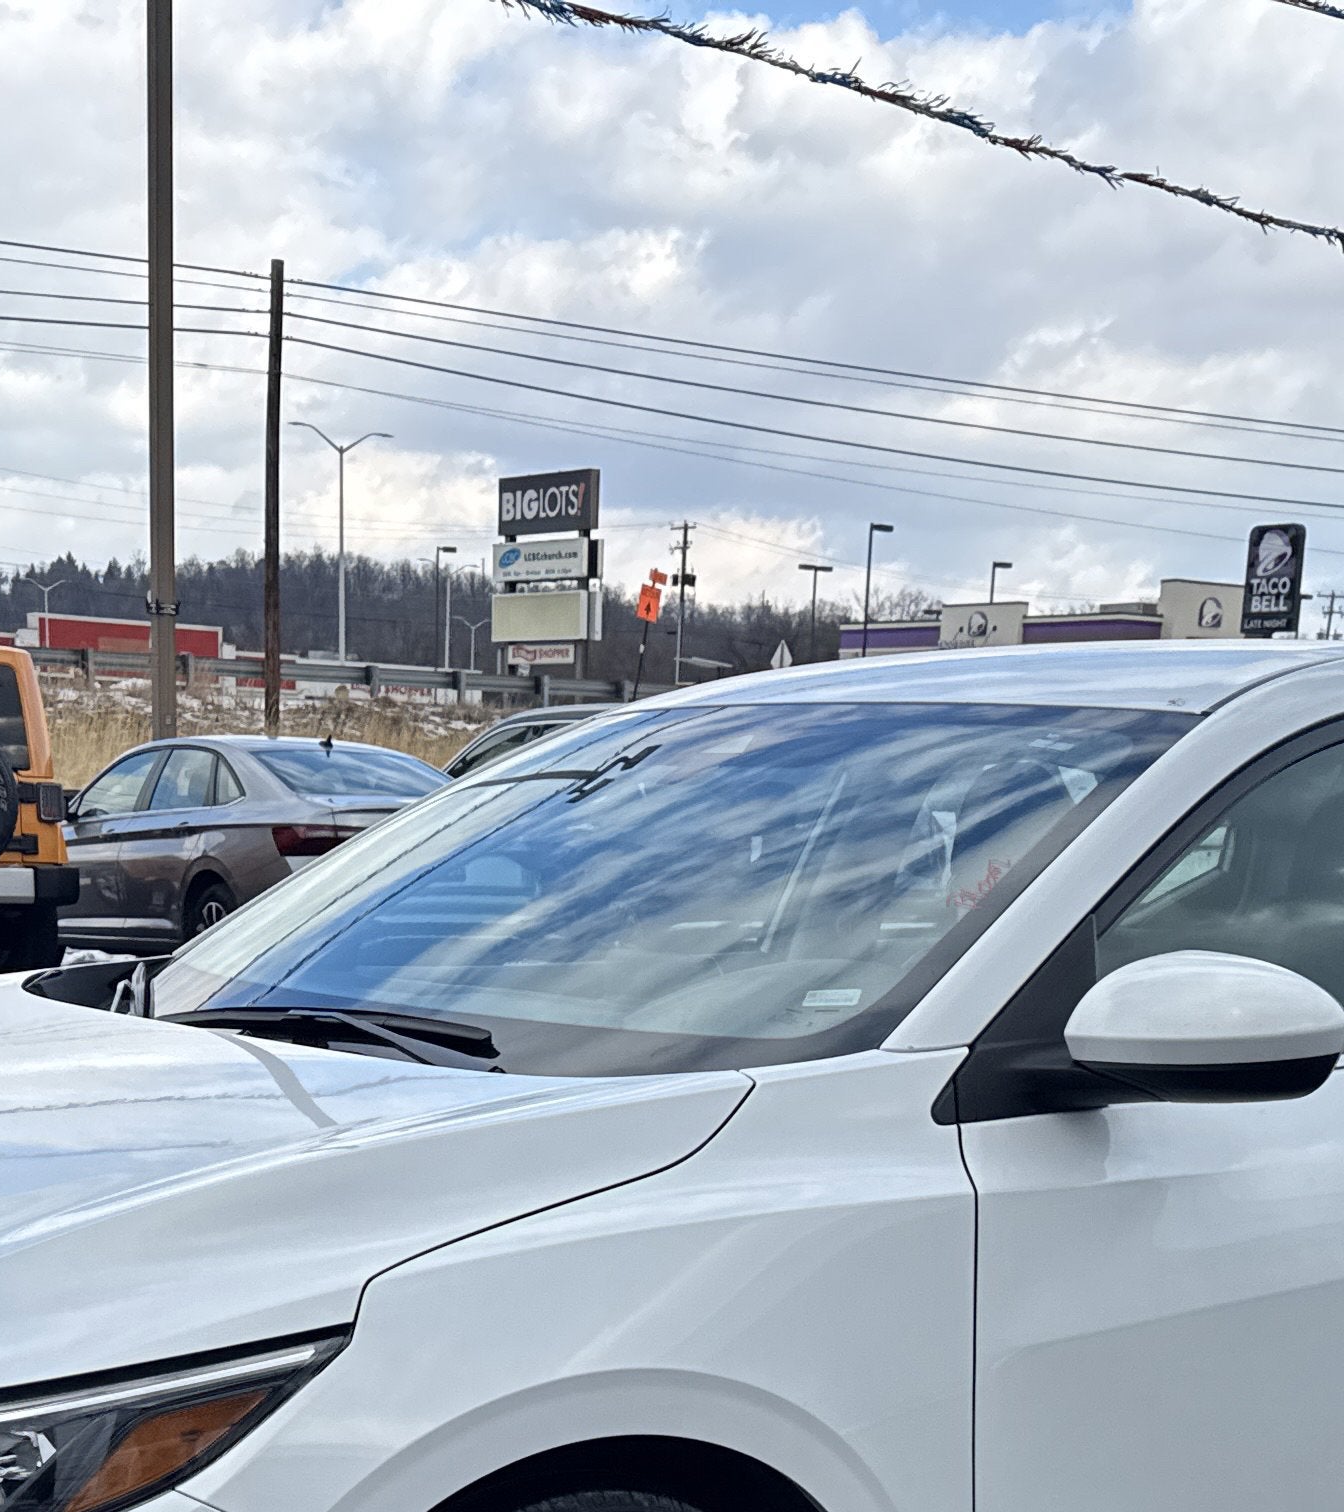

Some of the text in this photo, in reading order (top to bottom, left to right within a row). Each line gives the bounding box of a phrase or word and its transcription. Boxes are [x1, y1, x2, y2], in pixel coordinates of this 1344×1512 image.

[1249, 577, 1291, 595] TACO
[1250, 595, 1289, 613] BELL
[1243, 618, 1262, 629] LATE
